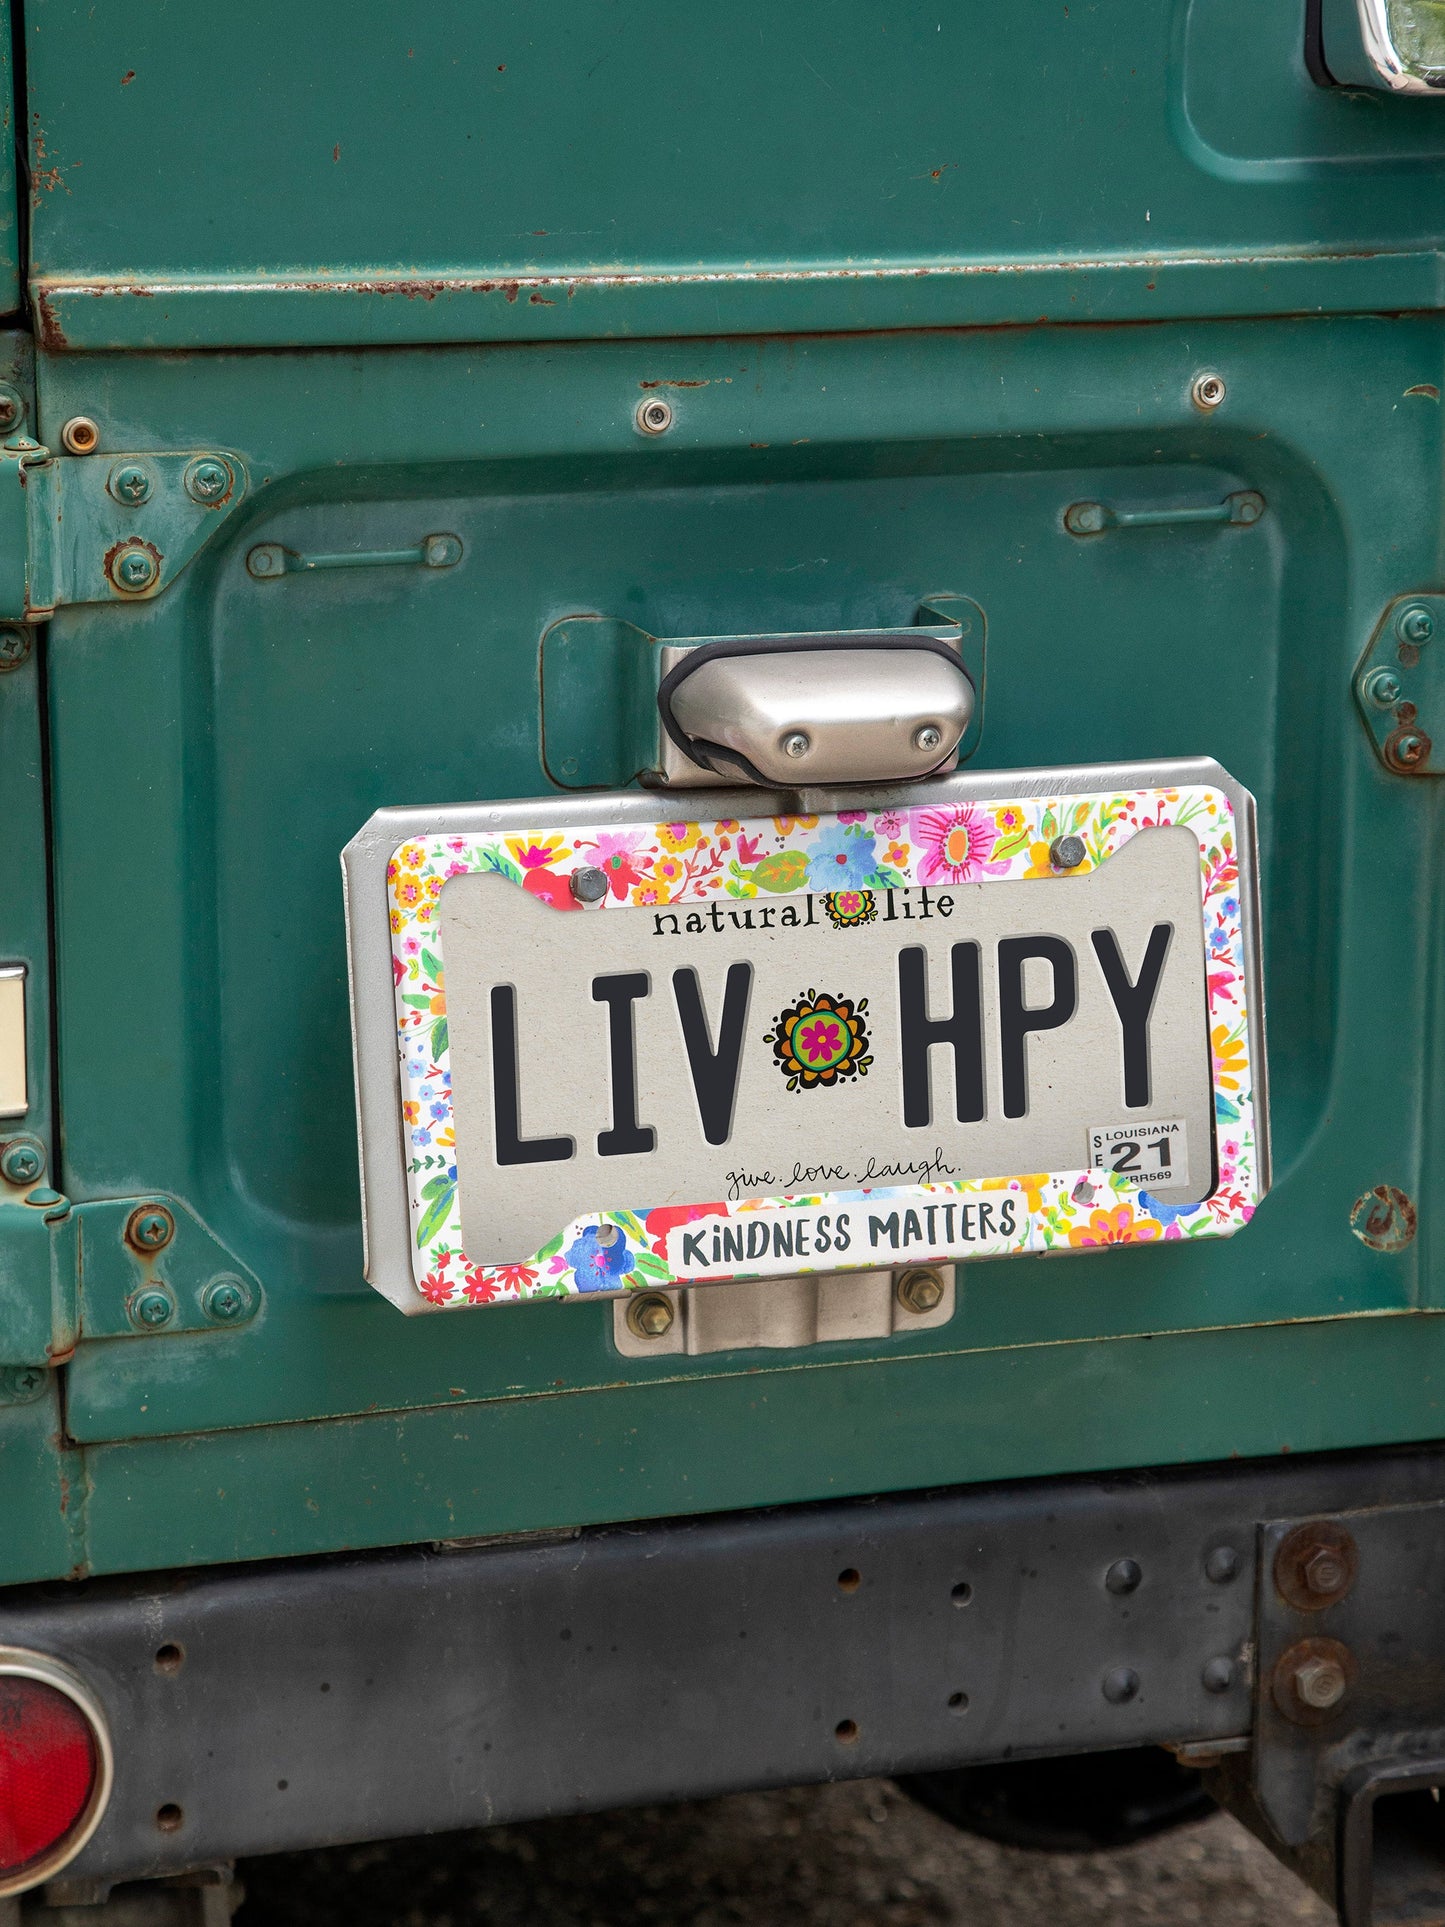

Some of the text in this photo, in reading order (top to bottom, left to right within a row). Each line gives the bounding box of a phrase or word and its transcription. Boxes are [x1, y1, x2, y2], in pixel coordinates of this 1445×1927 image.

[652, 887, 955, 936] natural life
[489, 924, 1171, 1166] LIV HPY
[1105, 1123, 1180, 1141] LOUISIANA
[1110, 1136, 1172, 1174] 21
[1124, 1170, 1172, 1184] RR569
[868, 1199, 1017, 1249] MATTERS
